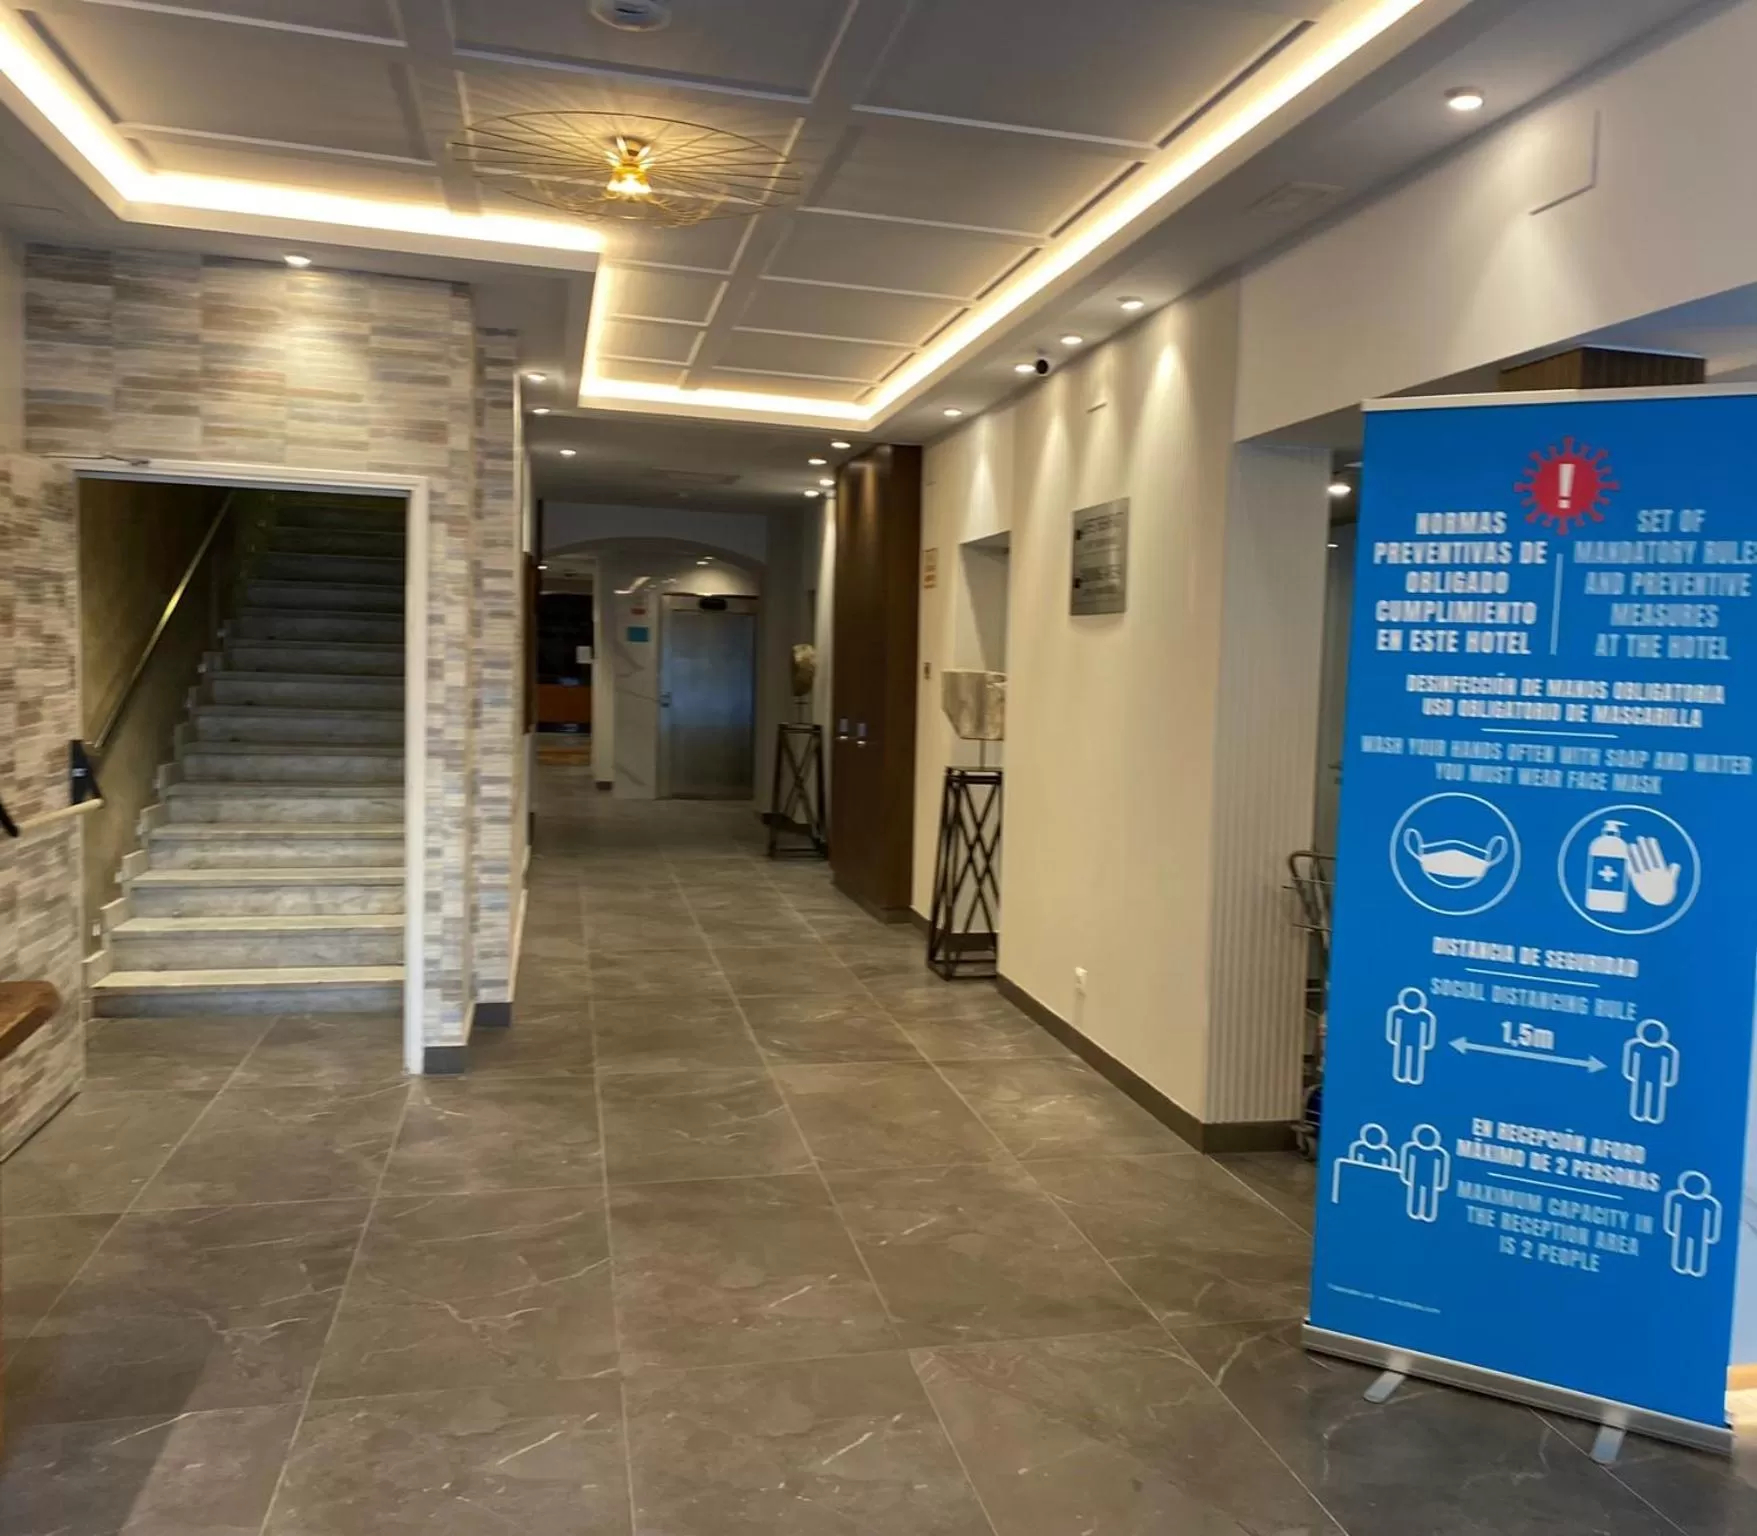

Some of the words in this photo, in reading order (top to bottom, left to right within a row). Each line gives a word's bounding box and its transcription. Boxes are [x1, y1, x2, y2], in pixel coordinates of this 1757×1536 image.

[1417, 513, 1506, 533] NORMAS
[1638, 511, 1671, 532] SET
[1679, 510, 1705, 531] OF
[1374, 543, 1511, 563] PREVENTIVAS
[1520, 542, 1546, 562] DE
[1574, 542, 1696, 563] MANDATORY
[1406, 572, 1508, 593] OBLIGADO
[1585, 573, 1624, 594] AND
[1632, 574, 1751, 596] PREVENTIVE
[1376, 601, 1536, 624] CUMPLIMIENTO
[1611, 604, 1718, 626] MEASURES
[1377, 631, 1401, 650] EN
[1410, 631, 1457, 651] ESTE
[1467, 632, 1530, 654] HOTEL
[1595, 634, 1618, 656] AT
[1627, 635, 1661, 657] THE
[1668, 636, 1730, 658] HOTEL
[1407, 674, 1516, 694] DESINFECCIÓN
[1522, 679, 1541, 695] DE
[1547, 680, 1607, 698] MANOS
[1614, 683, 1724, 703] OBLIGATORIA
[1423, 699, 1453, 715] USO
[1458, 701, 1560, 720] OBLIGATORIO
[1566, 705, 1587, 721] DE
[1593, 706, 1702, 726] MASCARILLA
[1362, 737, 1403, 753] WASH
[1409, 738, 1445, 755] YOUR
[1452, 740, 1502, 758] HANDS
[1508, 743, 1554, 762] OFTEN
[1559, 746, 1600, 765] WITH
[1605, 750, 1649, 767] SOAP
[1654, 753, 1687, 770] AND
[1694, 754, 1752, 774] WATER
[1436, 764, 1464, 780] YOU
[1469, 766, 1512, 783] MUST
[1518, 768, 1561, 787] WEAR
[1568, 771, 1607, 789] FACE
[1613, 773, 1661, 793] MASK
[1433, 937, 1513, 963] DISTANCIA
[1520, 947, 1541, 965] DE
[1546, 951, 1638, 976] SEGURIDAD
[1431, 979, 1484, 1000] SOCIAL
[1493, 986, 1587, 1015] DISTANCING
[1596, 998, 1636, 1020] RULE
[1473, 1119, 1491, 1137] EN
[1498, 1122, 1586, 1152] RECEPCIÓN
[1592, 1138, 1645, 1163] AFORO
[1531, 1151, 1551, 1171] DE
[1556, 1157, 1567, 1175] 2
[1572, 1161, 1660, 1191] PERSONAS
[1458, 1181, 1542, 1210] MAXIMUM
[1548, 1198, 1627, 1229] CAPACITY
[1637, 1215, 1652, 1234] IN
[1468, 1206, 1495, 1227] THE
[1502, 1212, 1588, 1246] RECEPTION
[1596, 1231, 1638, 1255] AREA
[1500, 1236, 1516, 1254] IS
[1521, 1241, 1532, 1257] 2
[1538, 1244, 1599, 1271] PEOPLE
